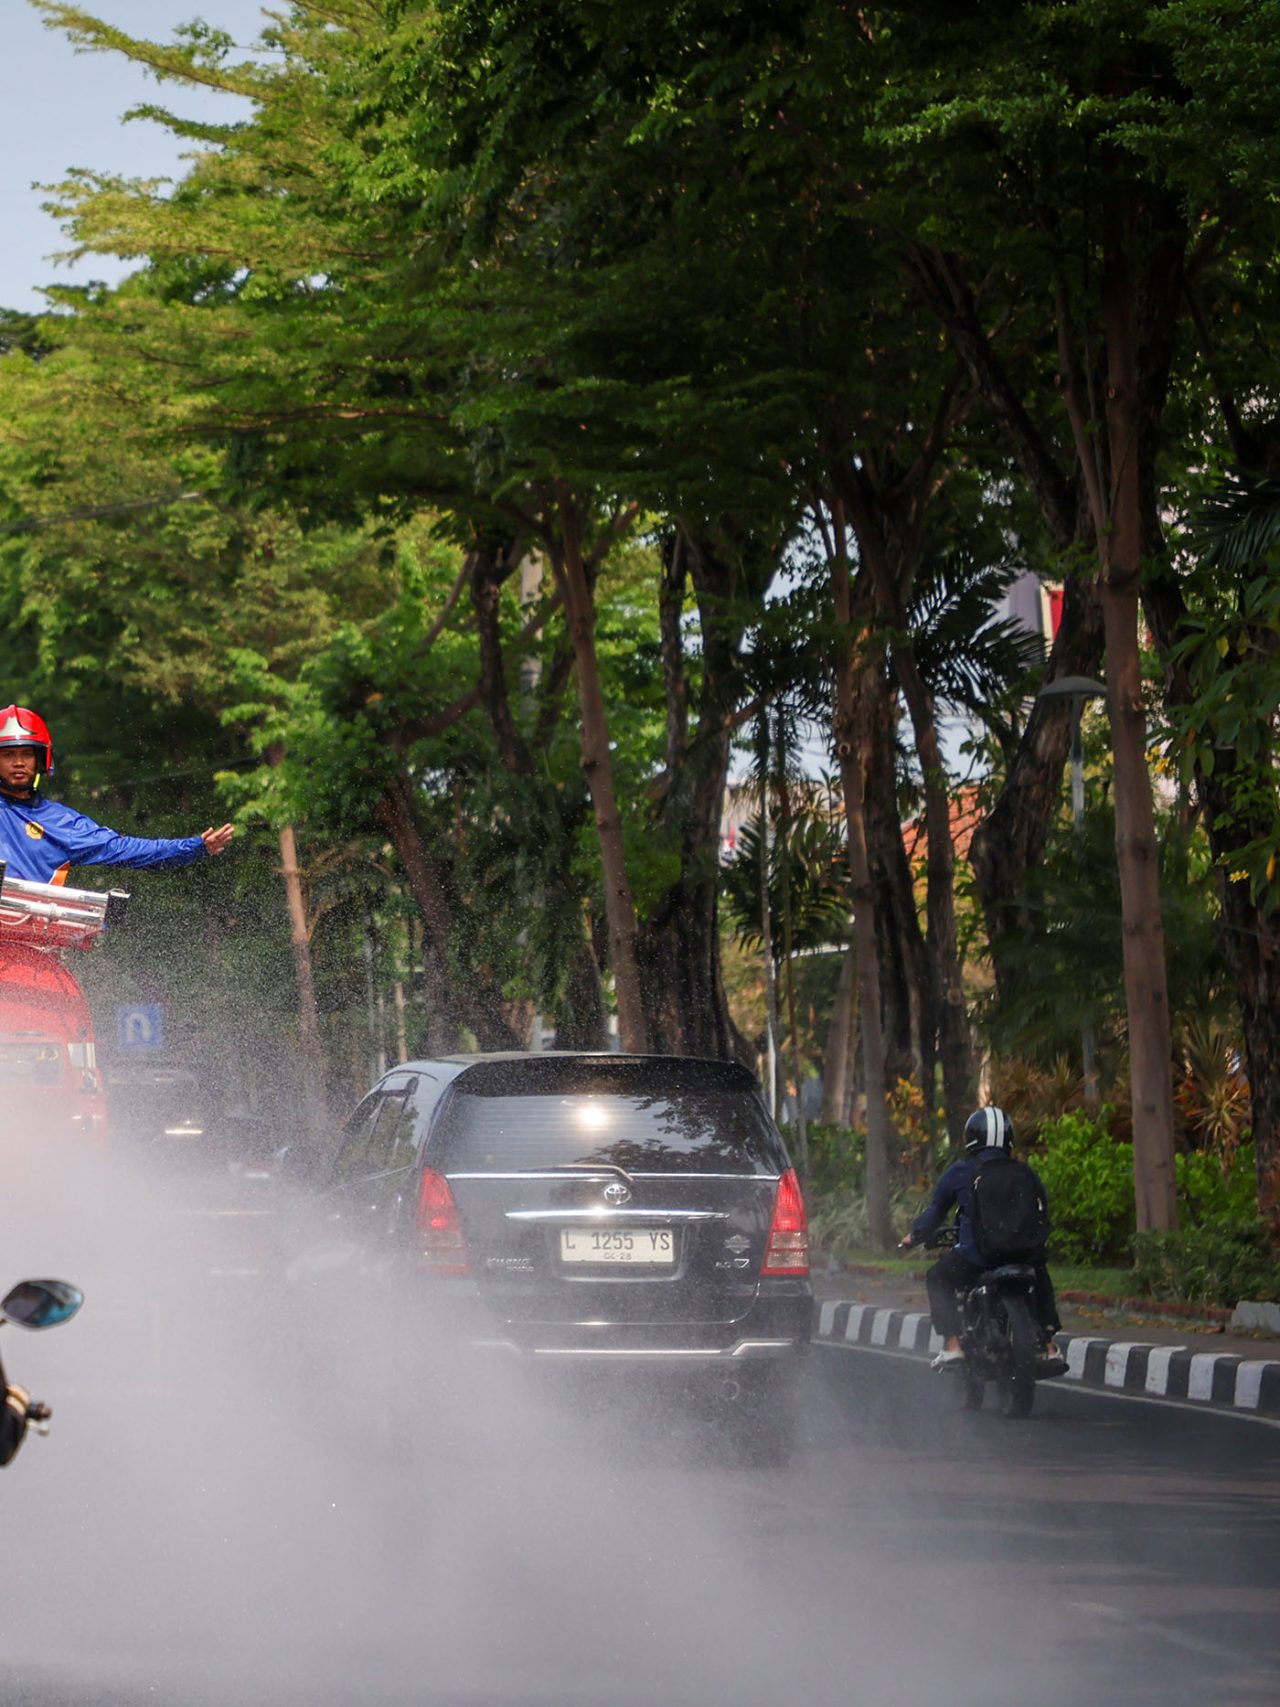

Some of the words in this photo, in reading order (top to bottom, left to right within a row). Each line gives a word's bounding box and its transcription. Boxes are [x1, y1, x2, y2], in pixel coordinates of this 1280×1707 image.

[565, 1231, 576, 1249] L
[591, 1231, 634, 1250] 1255
[649, 1231, 670, 1250] YS
